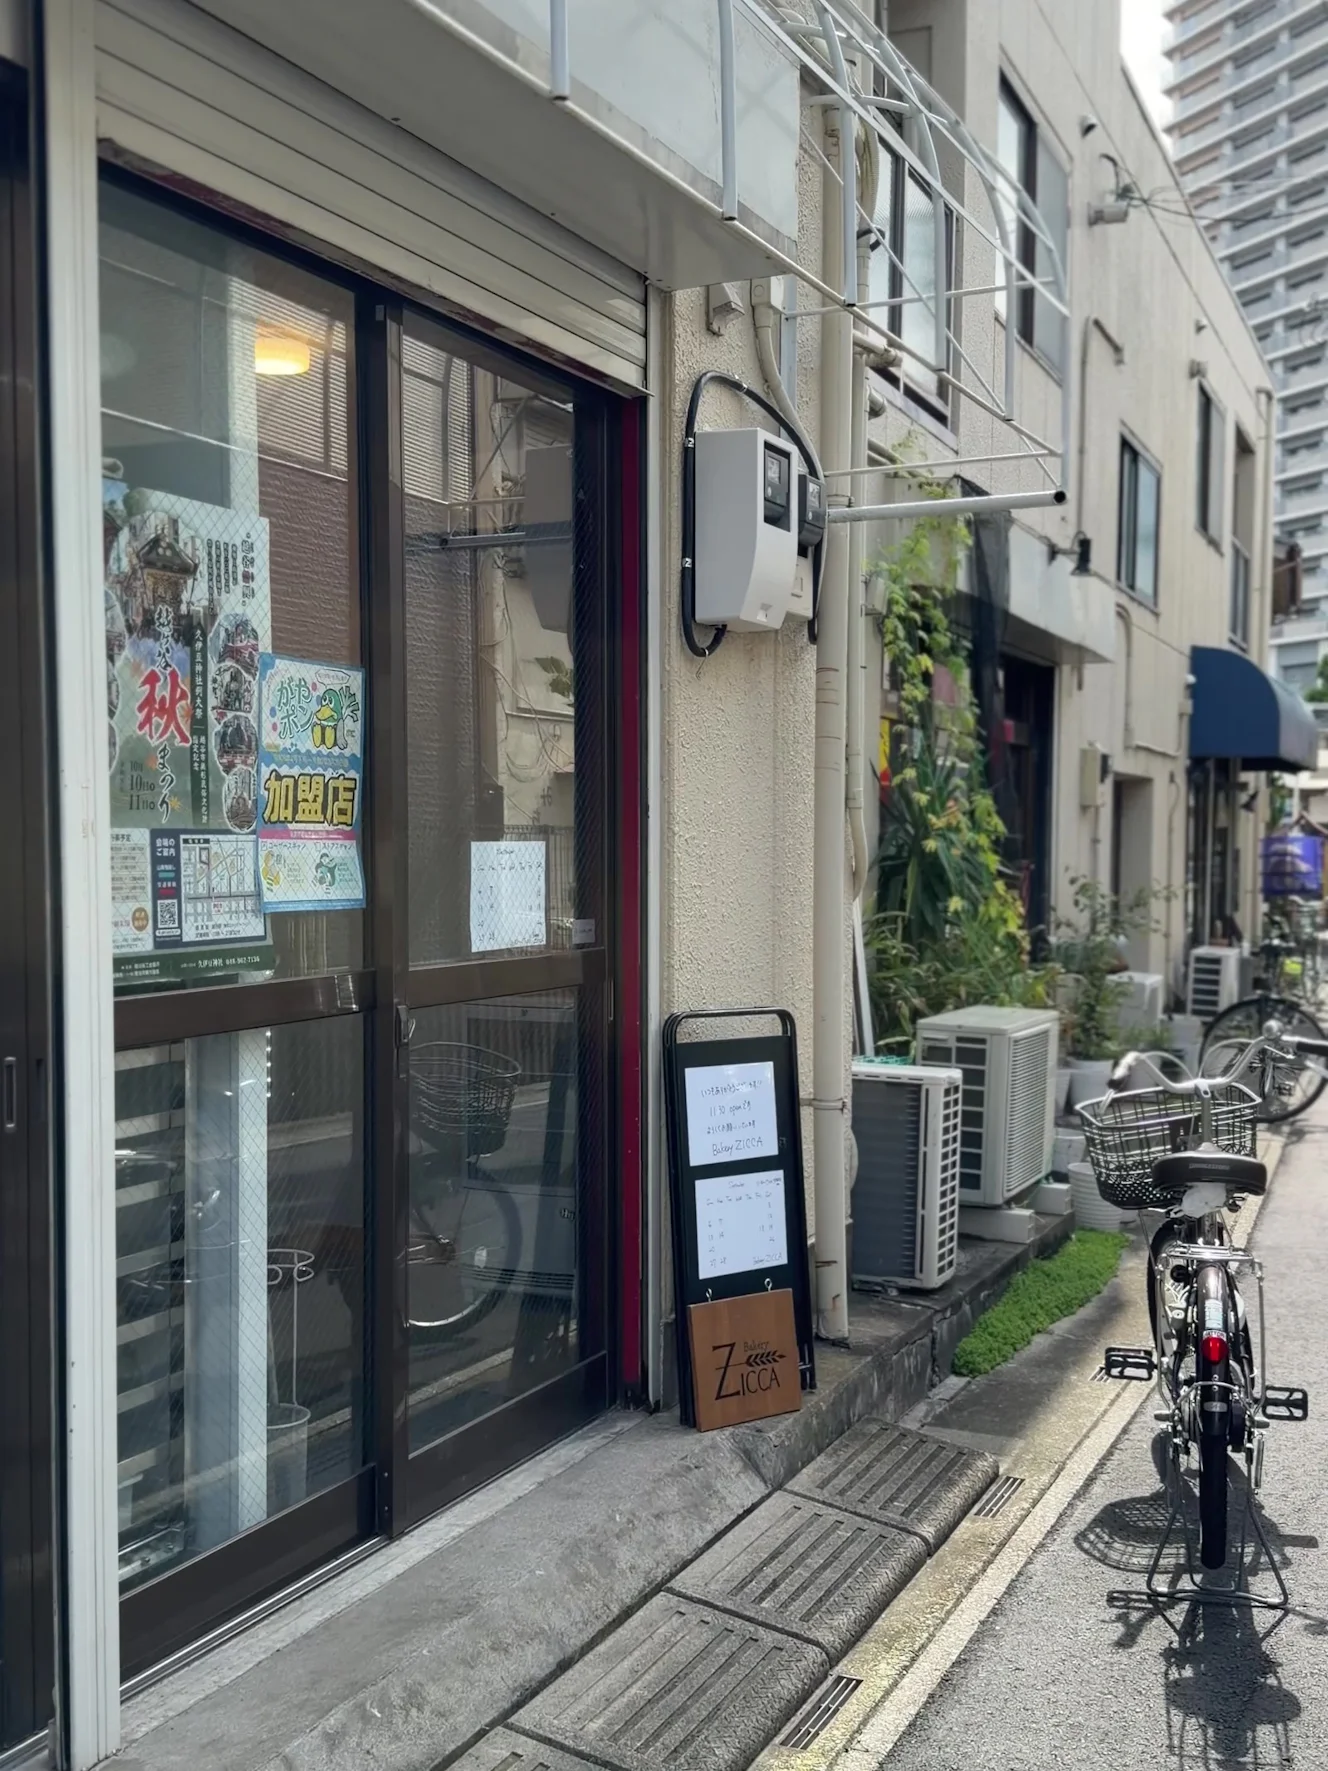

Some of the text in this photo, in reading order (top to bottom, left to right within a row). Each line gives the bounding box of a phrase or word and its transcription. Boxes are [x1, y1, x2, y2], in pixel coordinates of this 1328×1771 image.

[276, 676, 313, 711] がや
[279, 703, 314, 739] ポン
[262, 769, 357, 827] 加盟店
[155, 838, 175, 847] 会場の
[156, 848, 176, 857] ご案内
[735, 1136, 764, 1150] ZICCA
[744, 1341, 769, 1353] Bakery
[712, 1342, 781, 1401] ZICCA
